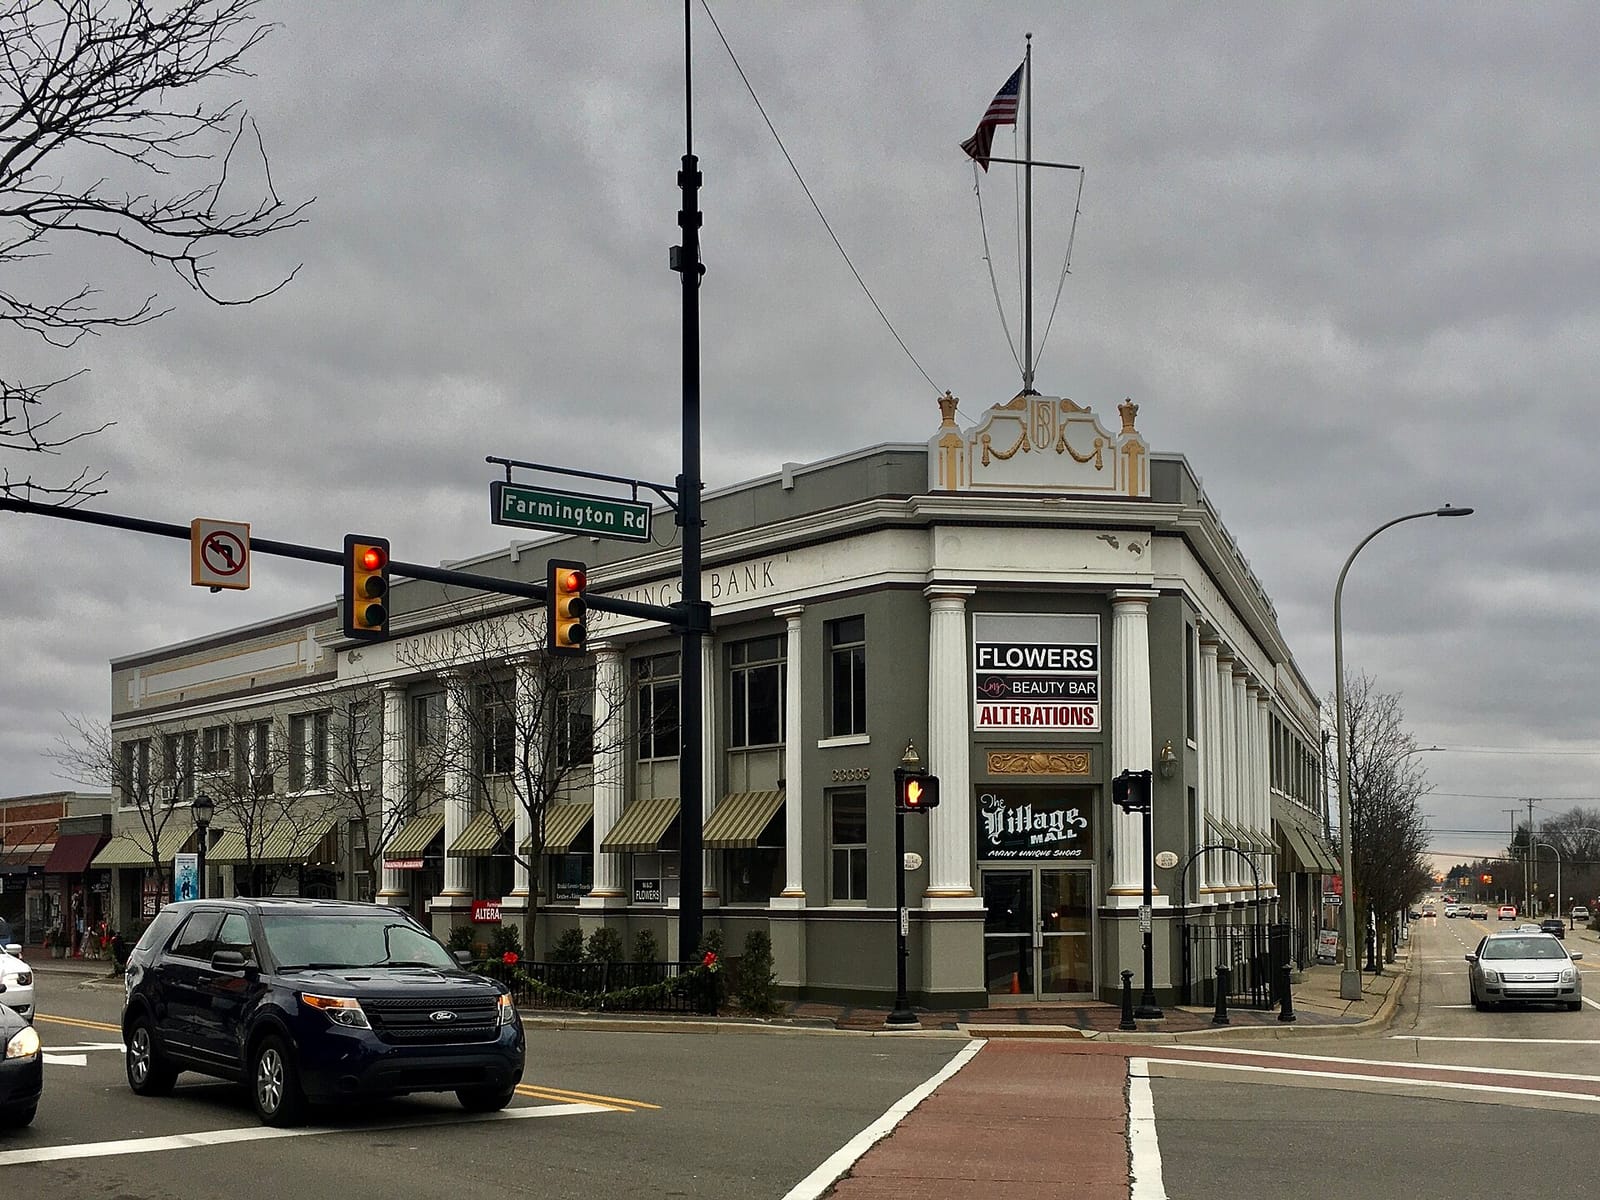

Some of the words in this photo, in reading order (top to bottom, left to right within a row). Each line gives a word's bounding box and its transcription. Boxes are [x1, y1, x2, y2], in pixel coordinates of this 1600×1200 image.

[505, 494, 614, 526] Farmington
[623, 510, 645, 529] Rd
[711, 561, 775, 599] BANK
[979, 647, 1094, 668] FLOWERS
[1012, 681, 1064, 694] BEAUTY
[1069, 682, 1096, 694] BAR
[980, 706, 1094, 725] ALTERATIONS
[980, 793, 1006, 809] The
[981, 803, 1088, 845] Village
[1030, 829, 1077, 845] MALL
[635, 890, 660, 900] FLOWERS
[474, 908, 502, 920] ALTERA
